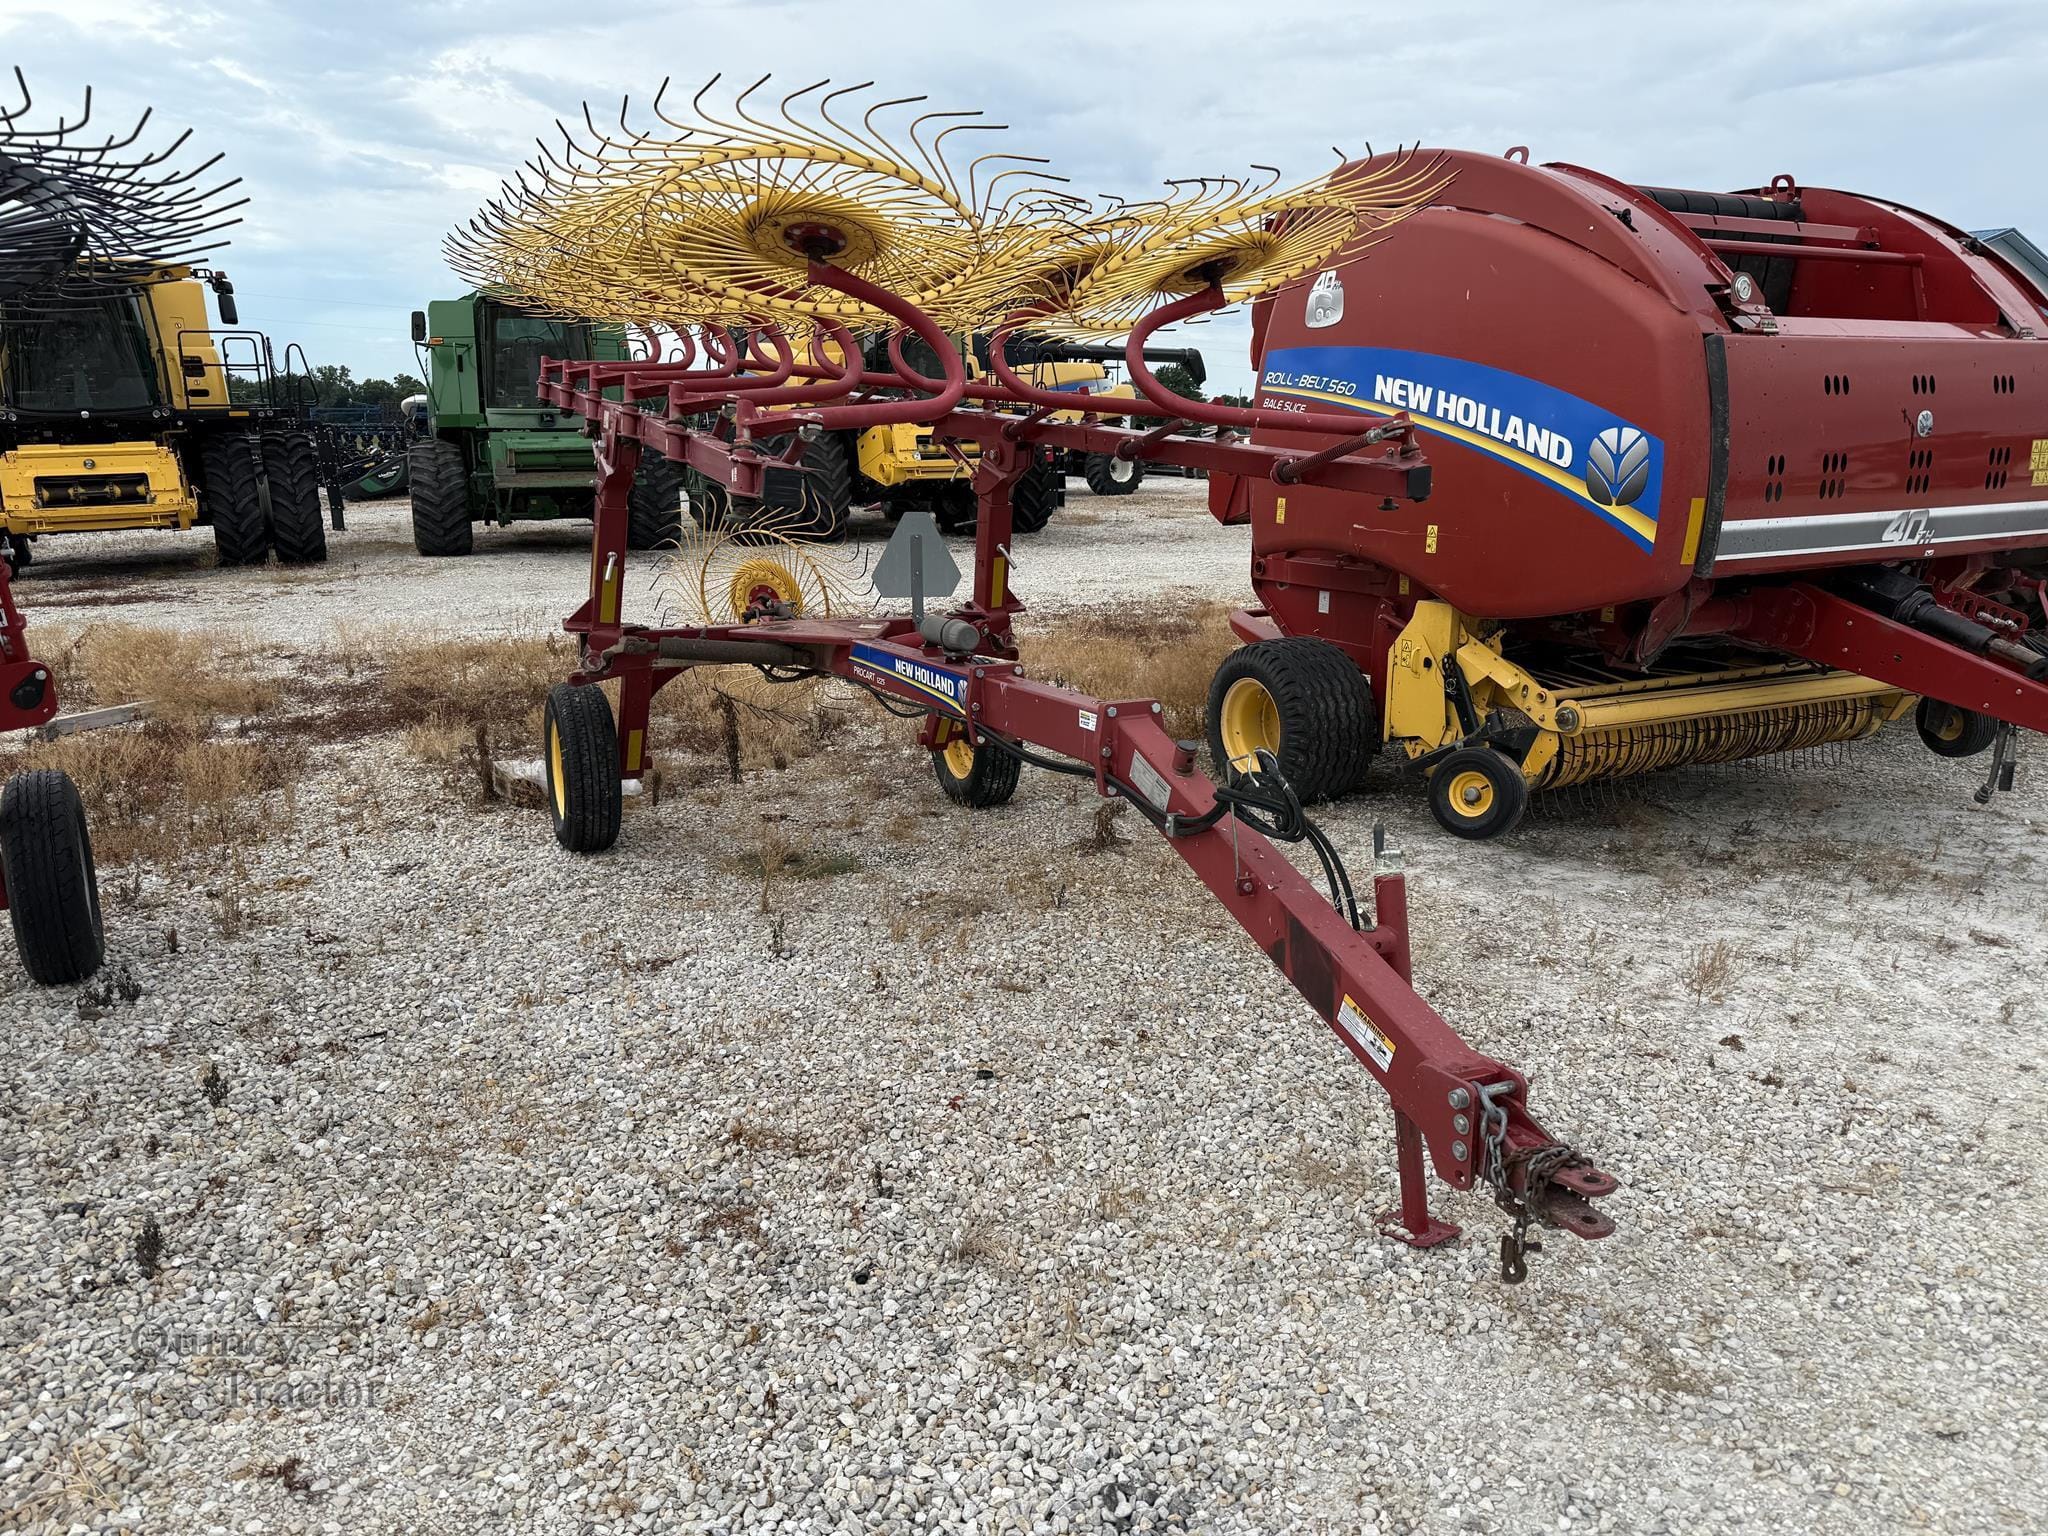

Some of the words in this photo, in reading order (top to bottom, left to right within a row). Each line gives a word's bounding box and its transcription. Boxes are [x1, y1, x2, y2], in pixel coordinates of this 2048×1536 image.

[1327, 379, 1356, 396] 560
[1263, 398, 1284, 411] BALE
[1283, 401, 1306, 413] SLICE
[1374, 374, 1433, 413] NEW
[1436, 389, 1573, 468] HOLLAND
[853, 665, 875, 682] PROCART
[895, 658, 914, 679] NEW
[914, 665, 955, 697] HOLLAND
[1359, 1010, 1386, 1042] WARNING
